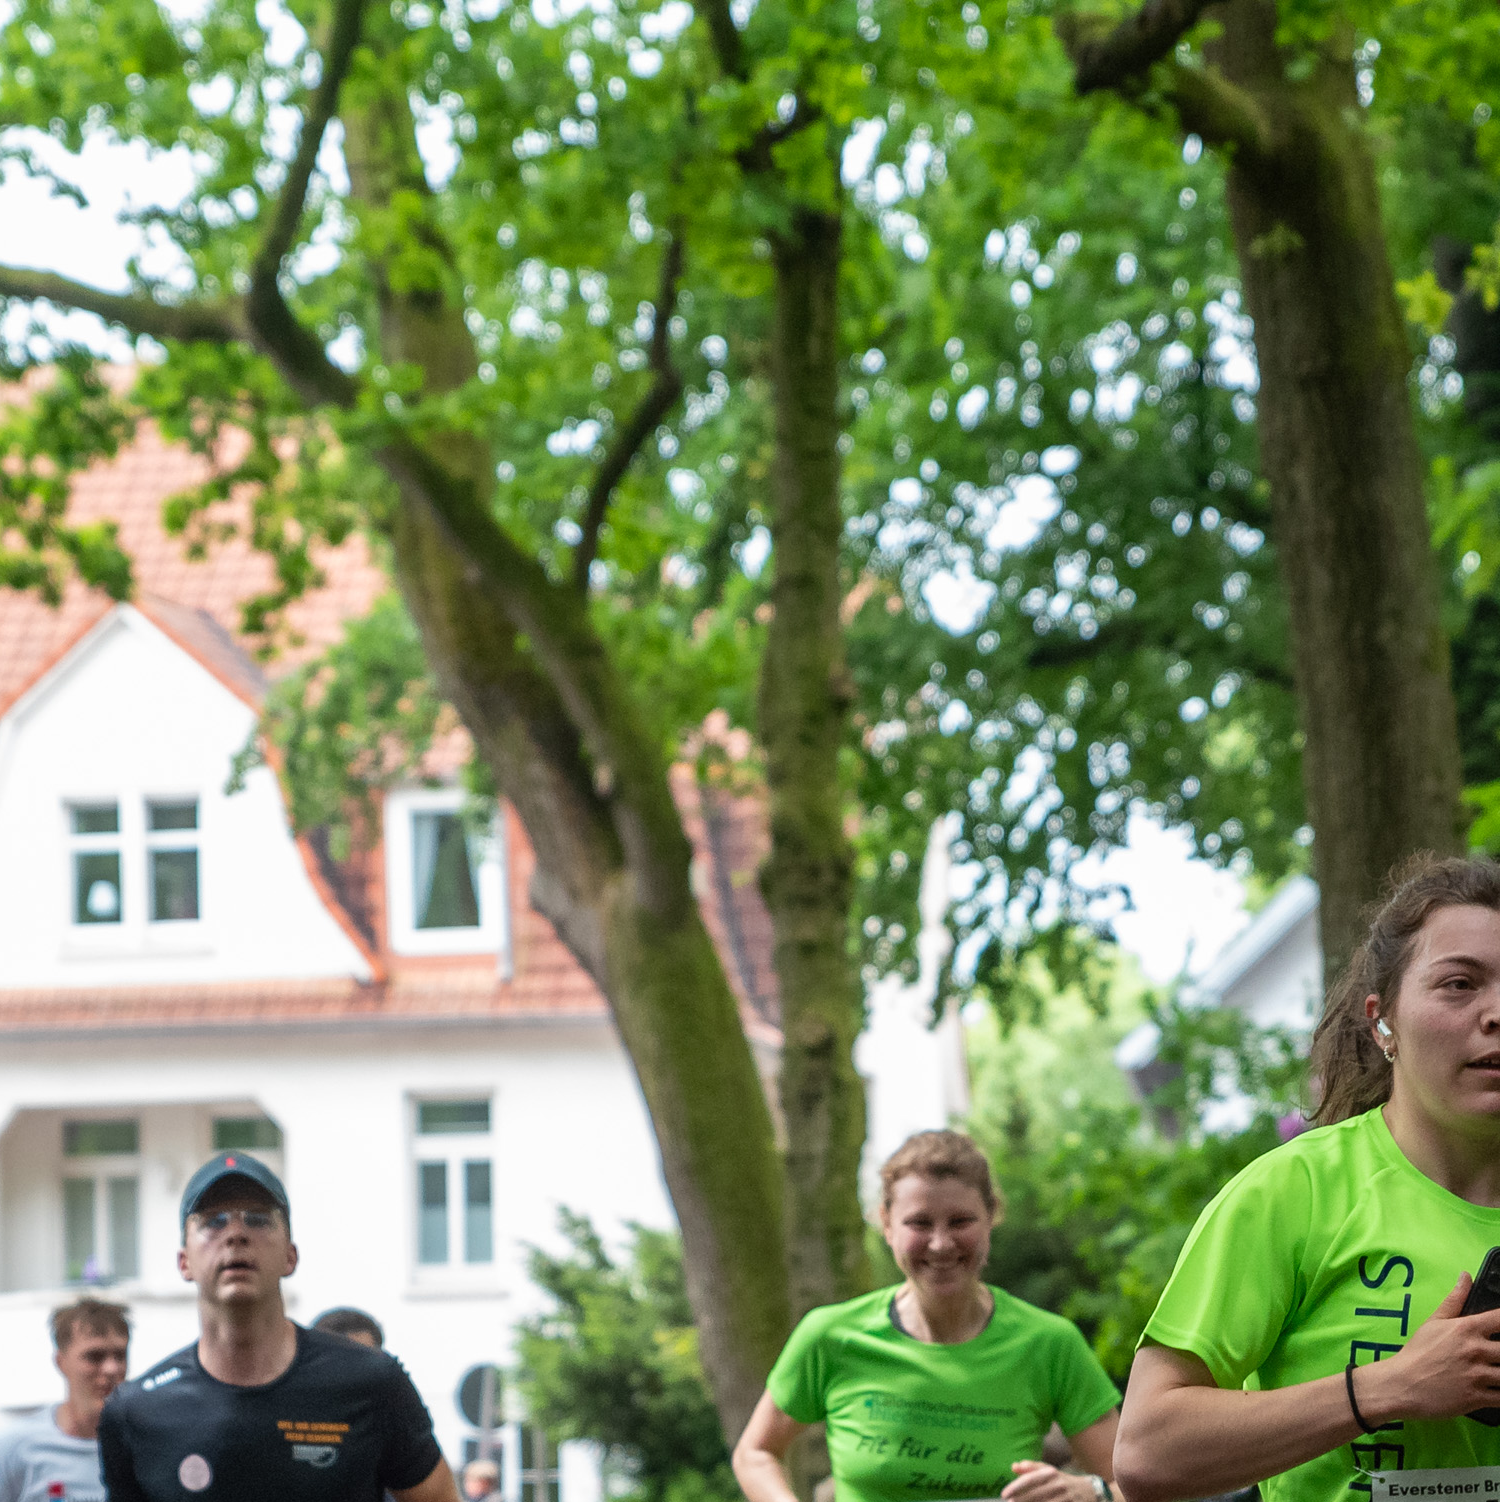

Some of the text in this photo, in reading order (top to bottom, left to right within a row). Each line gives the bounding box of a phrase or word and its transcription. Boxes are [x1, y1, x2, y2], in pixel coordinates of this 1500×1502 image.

[856, 1436, 985, 1465] Fit für die
[1389, 1483, 1480, 1497] Everstener
